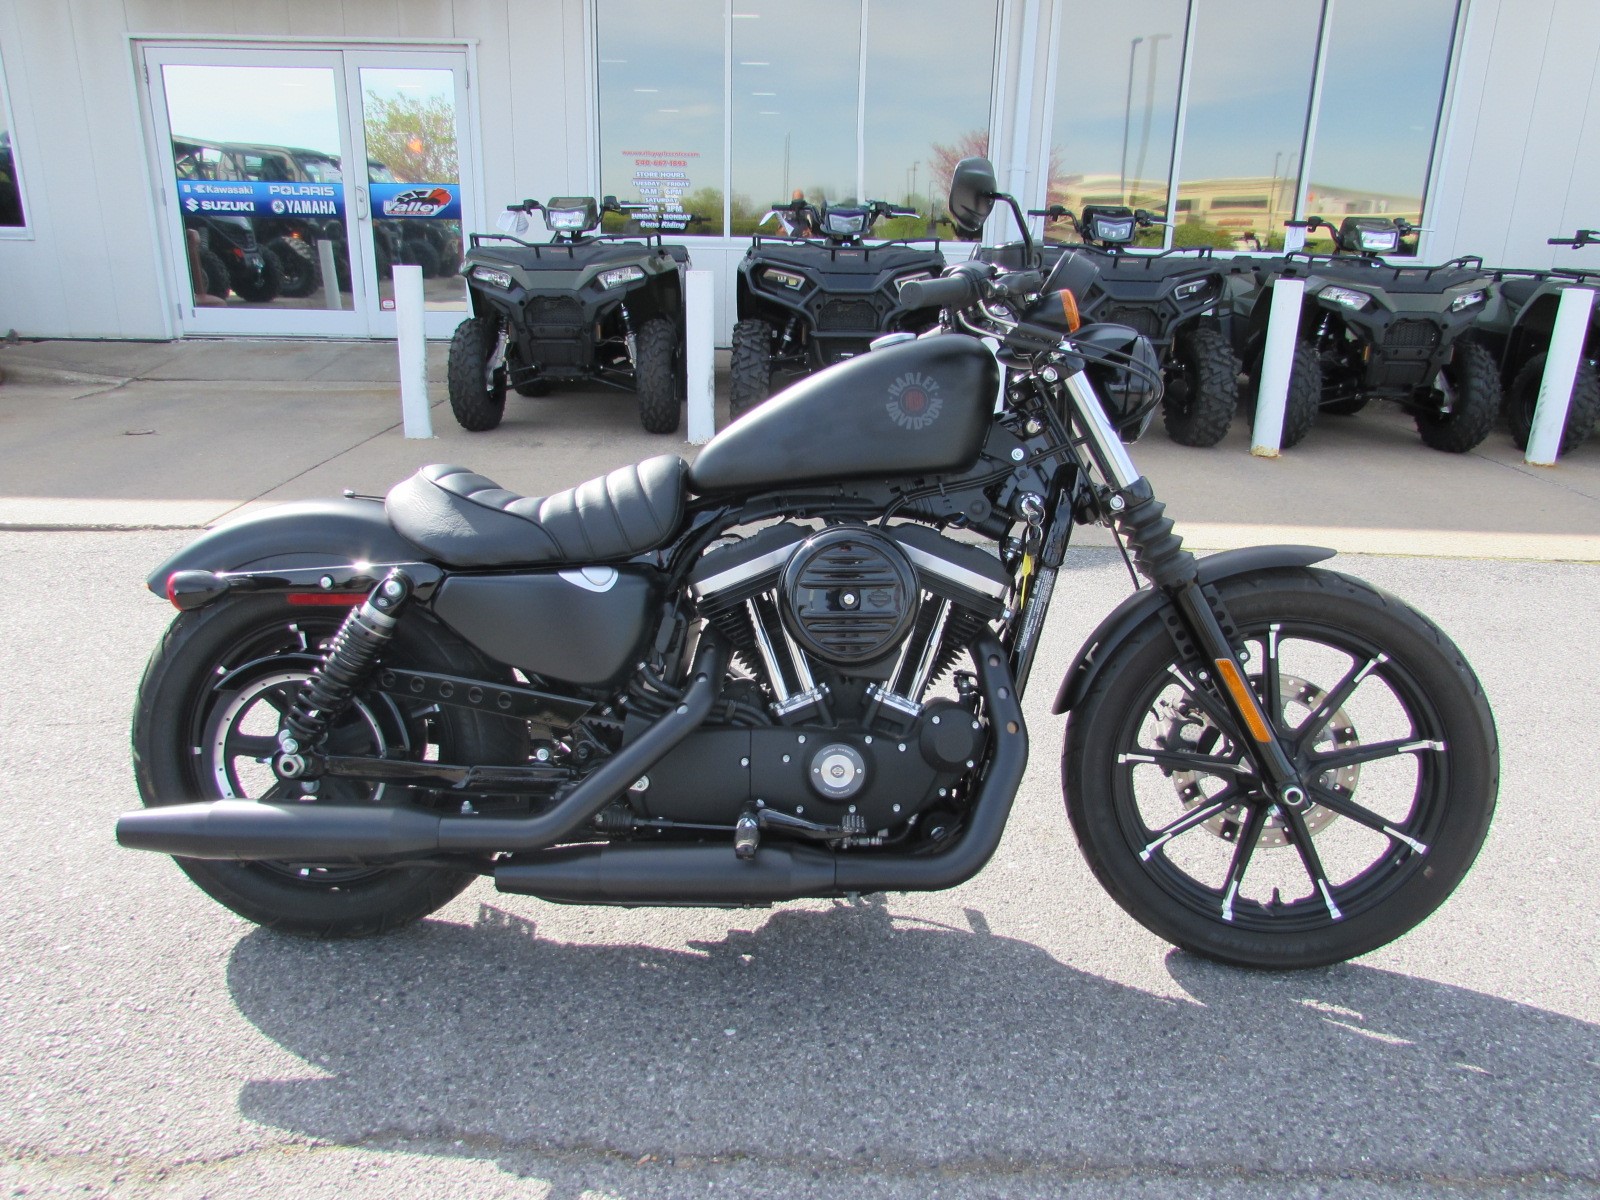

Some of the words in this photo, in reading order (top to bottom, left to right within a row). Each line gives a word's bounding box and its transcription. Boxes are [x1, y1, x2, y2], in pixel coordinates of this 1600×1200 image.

[206, 185, 253, 195] Kawasaki
[269, 185, 335, 196] POLARIS
[202, 201, 255, 212] SUZUKI
[286, 200, 337, 214] YAMAHA
[383, 200, 446, 213] Valley
[661, 221, 686, 229] Riding
[887, 372, 940, 397] HARLEY
[885, 398, 943, 430] DAVIDSON
